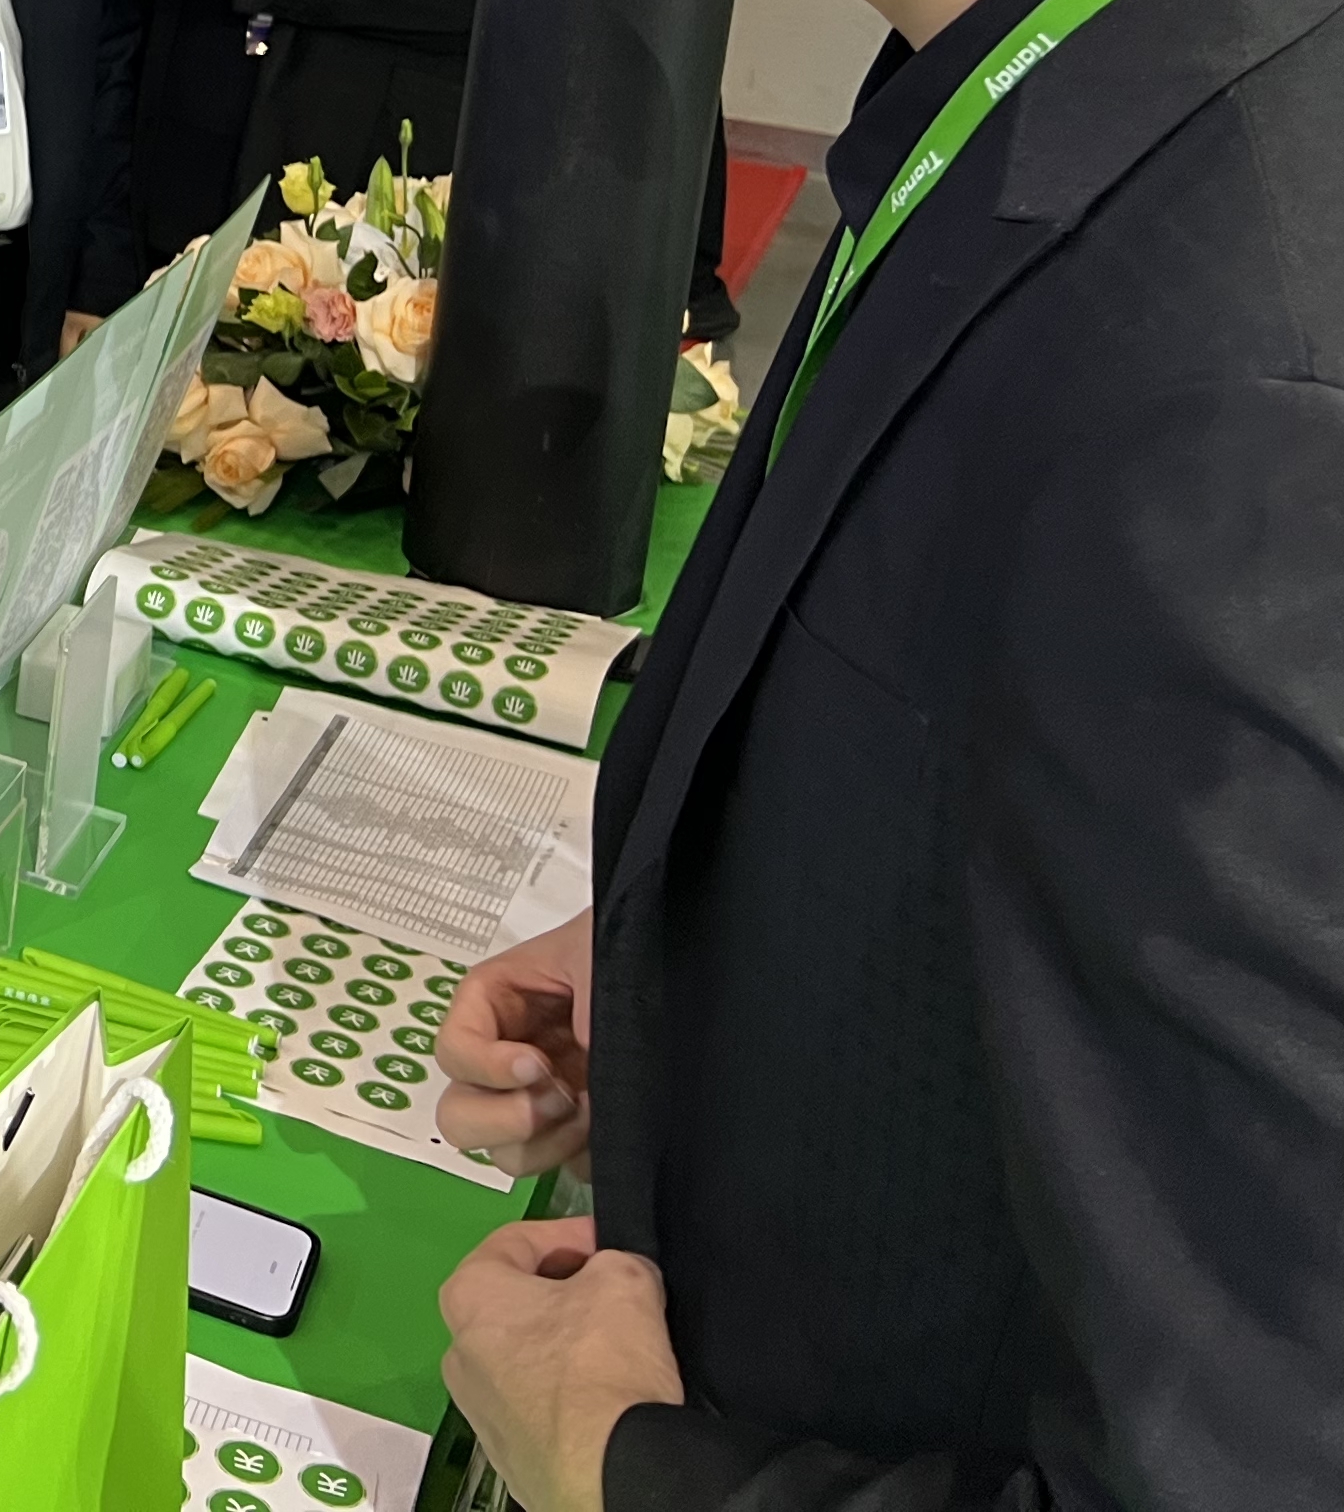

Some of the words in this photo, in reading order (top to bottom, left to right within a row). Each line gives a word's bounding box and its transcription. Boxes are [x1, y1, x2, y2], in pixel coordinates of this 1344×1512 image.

[983, 33, 1058, 100] Tiandy
[890, 151, 944, 212] Tiandy
[145, 591, 165, 611] 业
[194, 605, 214, 625] 业
[244, 619, 264, 640] 业
[294, 634, 314, 655] 业
[346, 649, 365, 670] 业
[398, 665, 418, 686] 业
[450, 681, 471, 701] 业
[503, 696, 524, 717] 业
[235, 942, 260, 958] 天
[296, 962, 320, 979] 天
[358, 984, 382, 1000] 天
[254, 918, 277, 933] 天
[314, 939, 337, 954] 天
[375, 959, 399, 975] 天
[216, 967, 240, 982] 天
[278, 989, 302, 1005] 天
[340, 1010, 365, 1027] 天
[405, 1033, 429, 1049] 天
[304, 1064, 328, 1081] 天
[370, 1086, 395, 1104] 天
[322, 1036, 347, 1053] 天
[387, 1062, 411, 1077] 天
[234, 1449, 263, 1473] 天
[318, 1473, 347, 1496] 天
